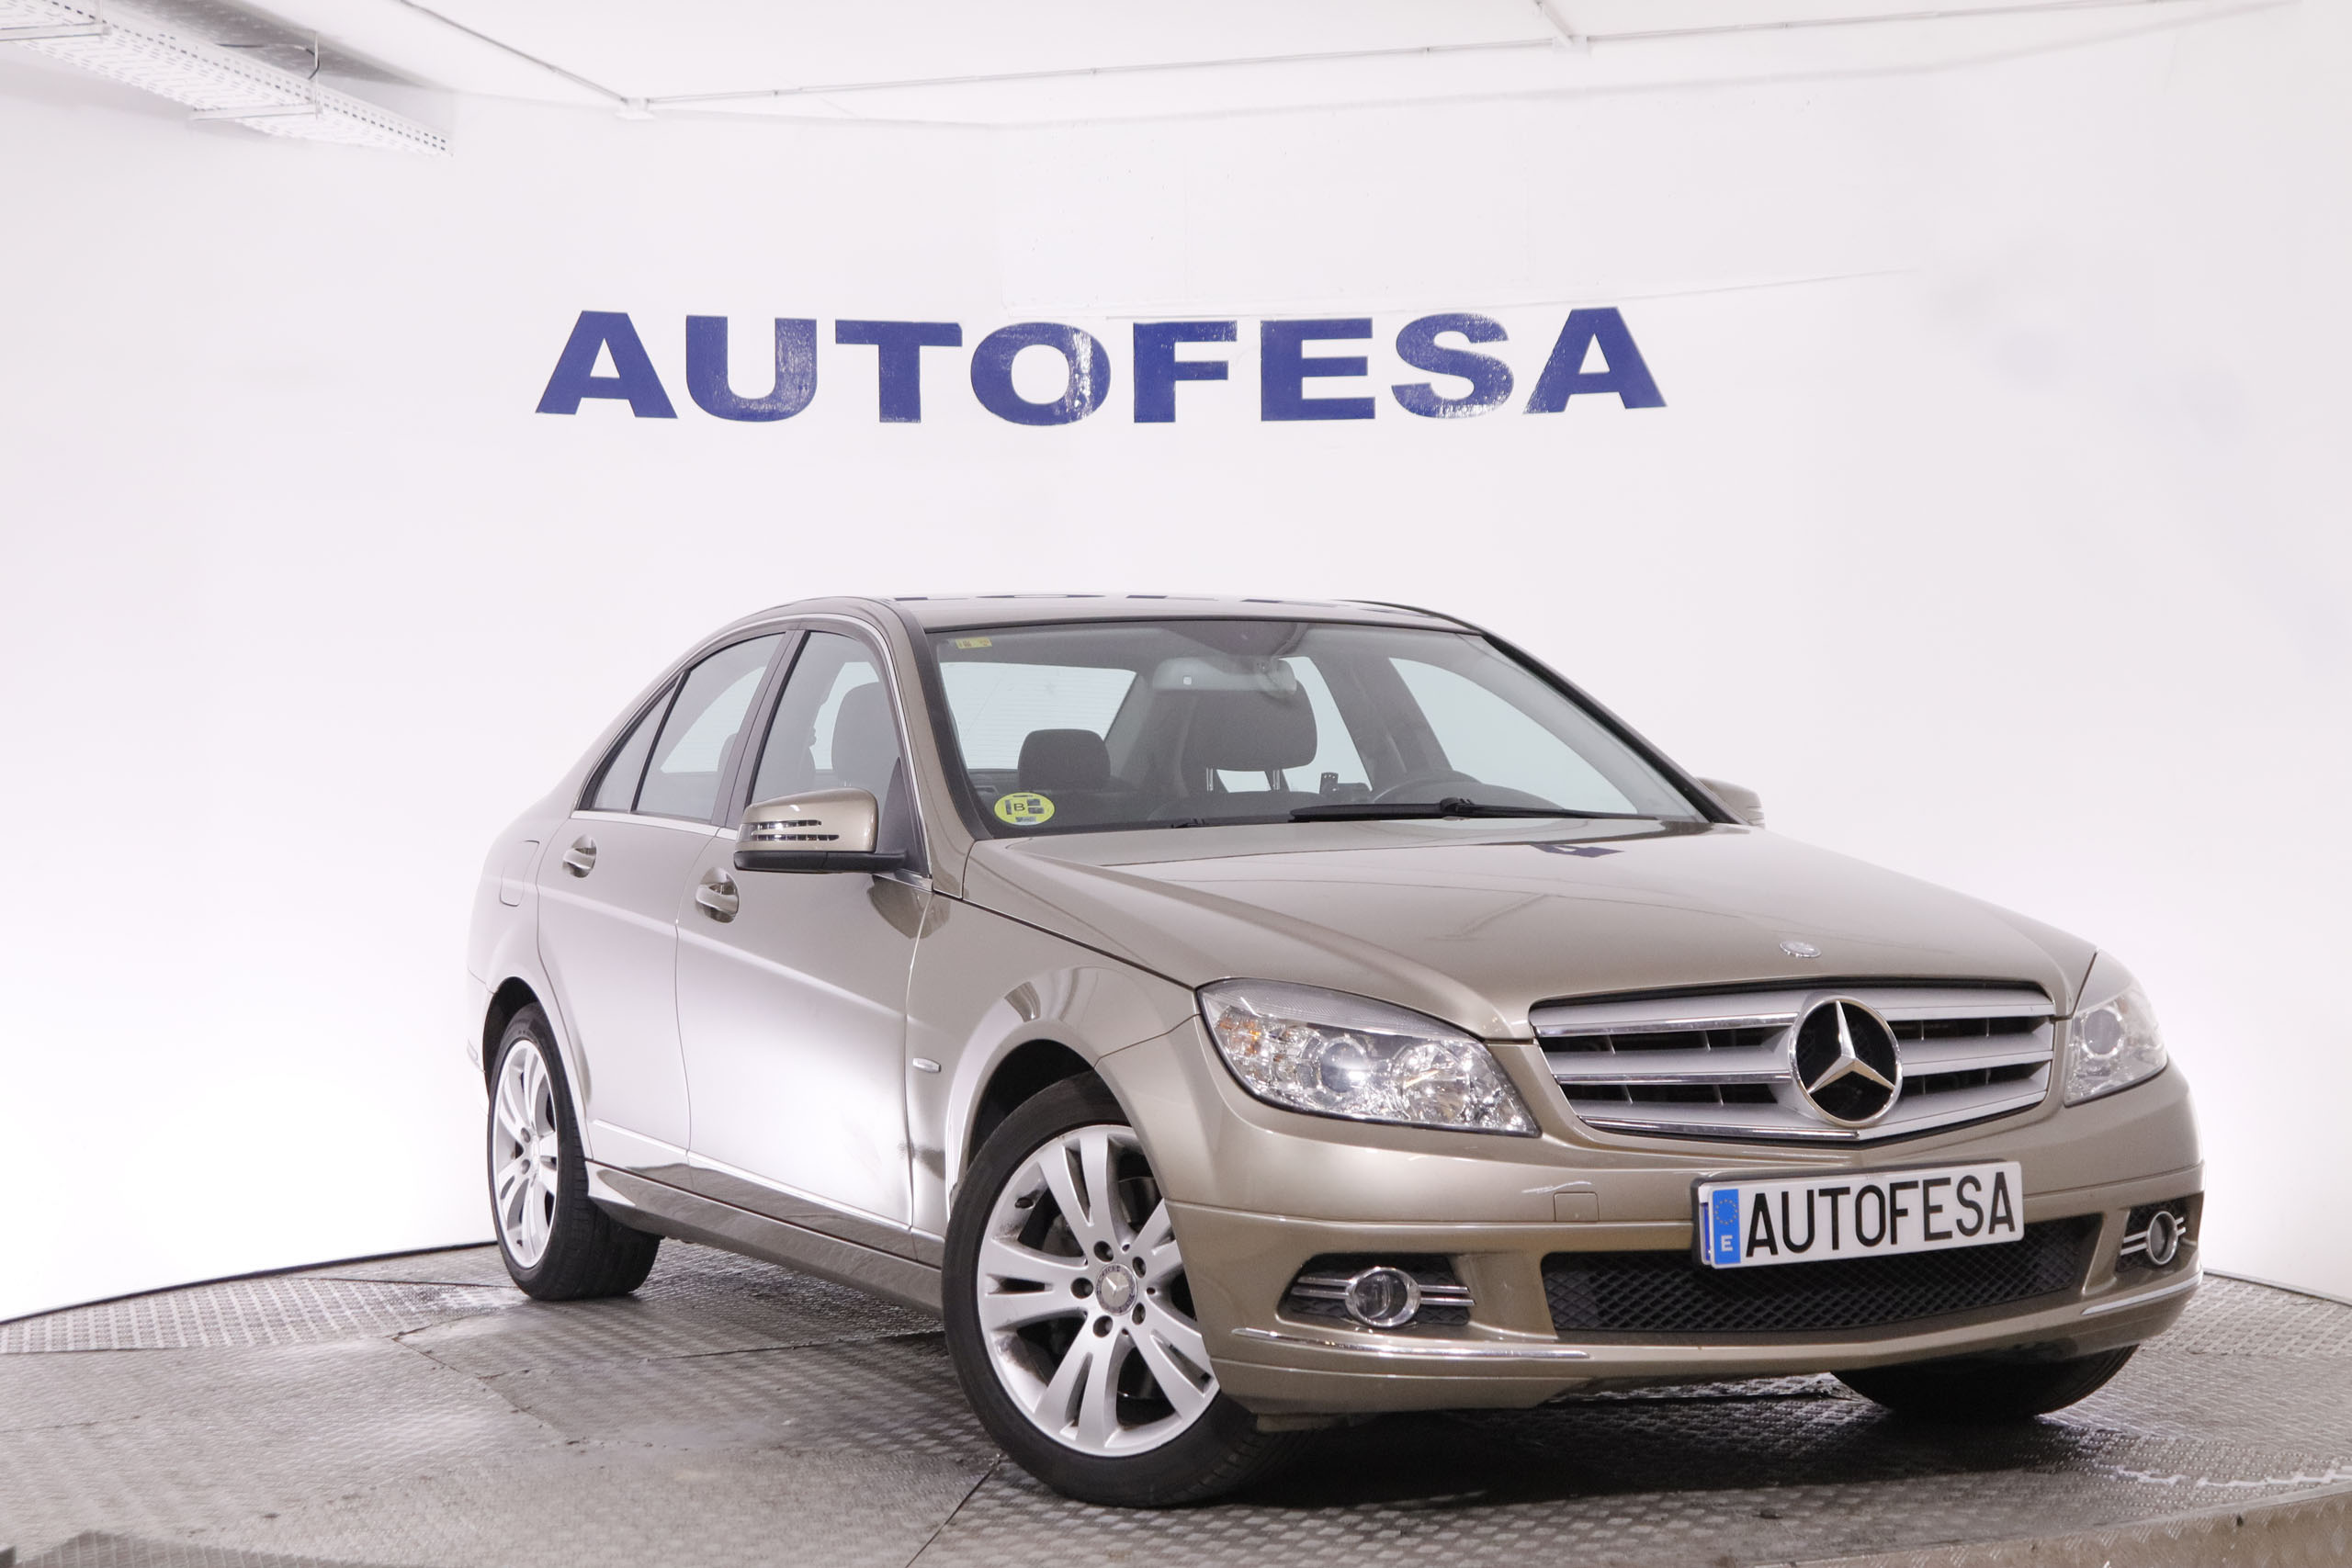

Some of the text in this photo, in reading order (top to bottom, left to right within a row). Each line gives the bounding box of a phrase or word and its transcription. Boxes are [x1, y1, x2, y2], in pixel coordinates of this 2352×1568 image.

[535, 307, 1668, 425] AUTOFESA
[1013, 803, 1025, 811] B
[1721, 1171, 2016, 1258] E AUTOFESA
